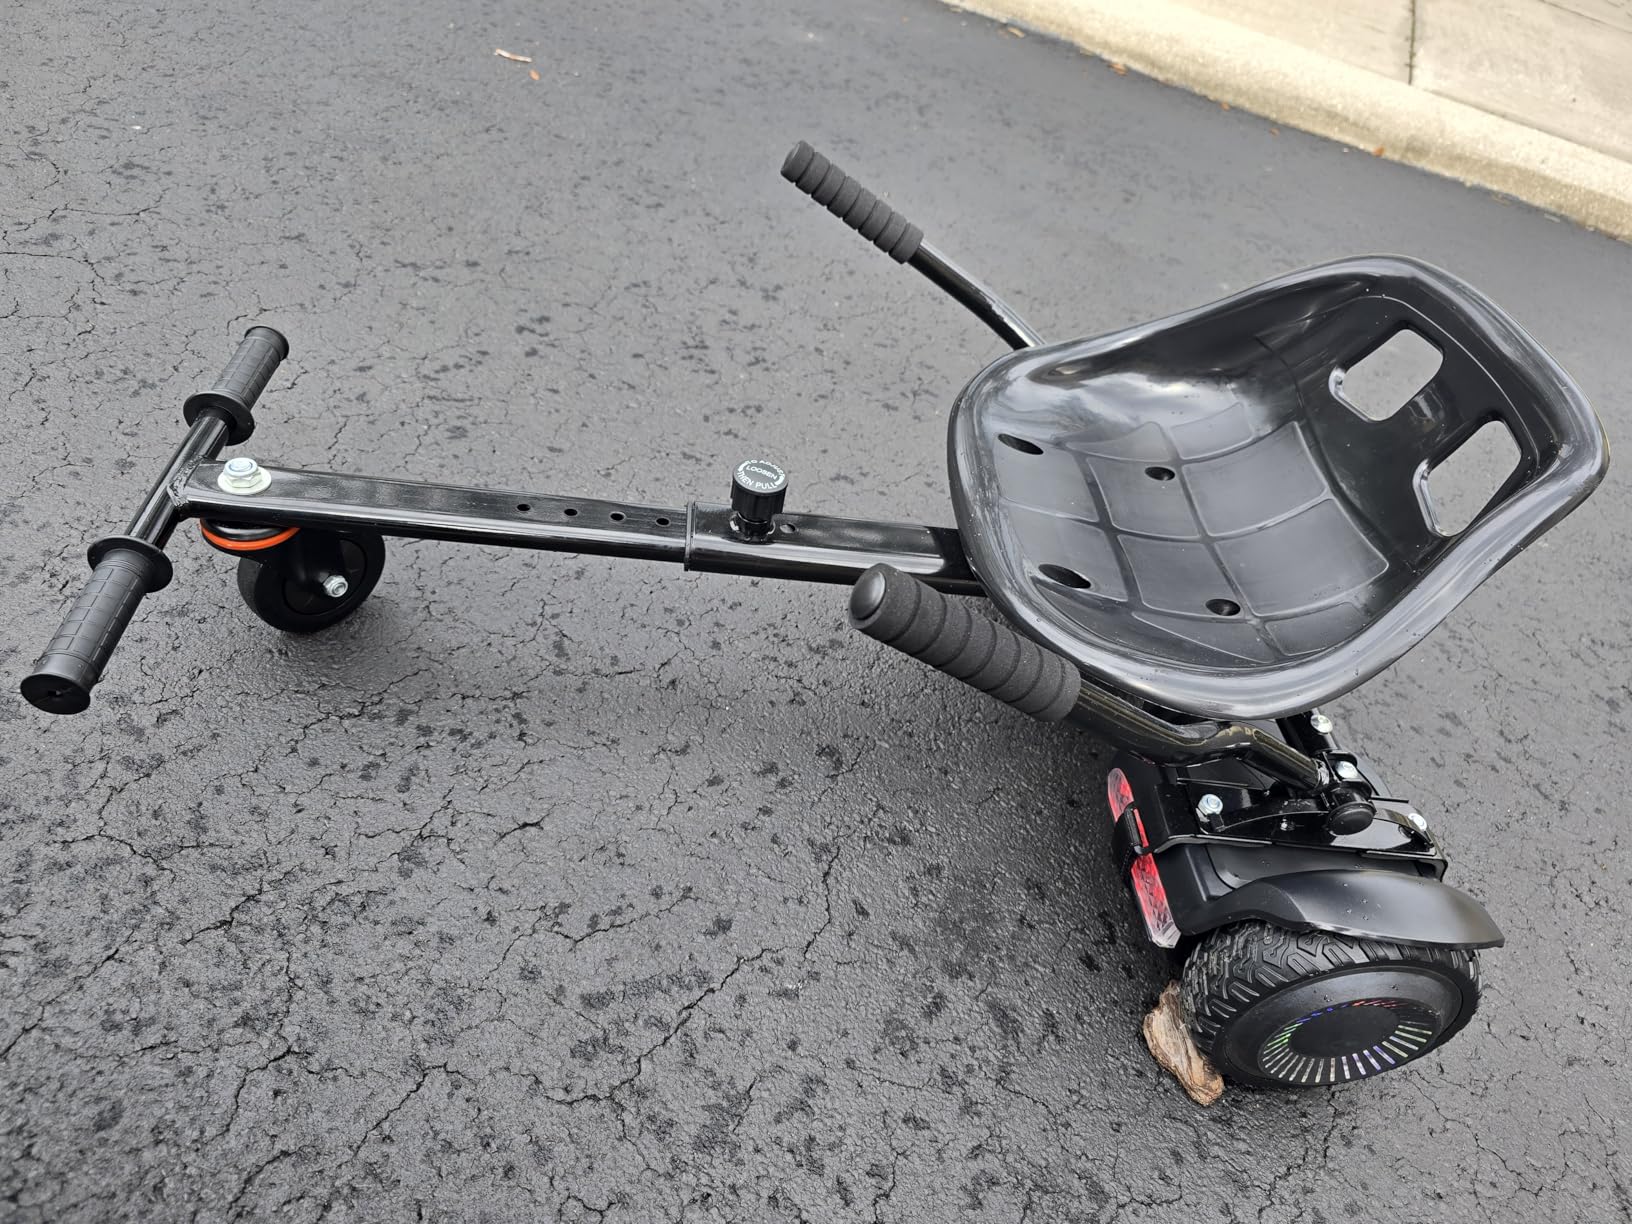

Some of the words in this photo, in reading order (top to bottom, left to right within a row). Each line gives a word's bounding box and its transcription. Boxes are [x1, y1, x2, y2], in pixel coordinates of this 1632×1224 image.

[737, 471, 754, 486] THEN
[755, 481, 777, 490] PULL
[746, 465, 777, 480] LOOSEN
